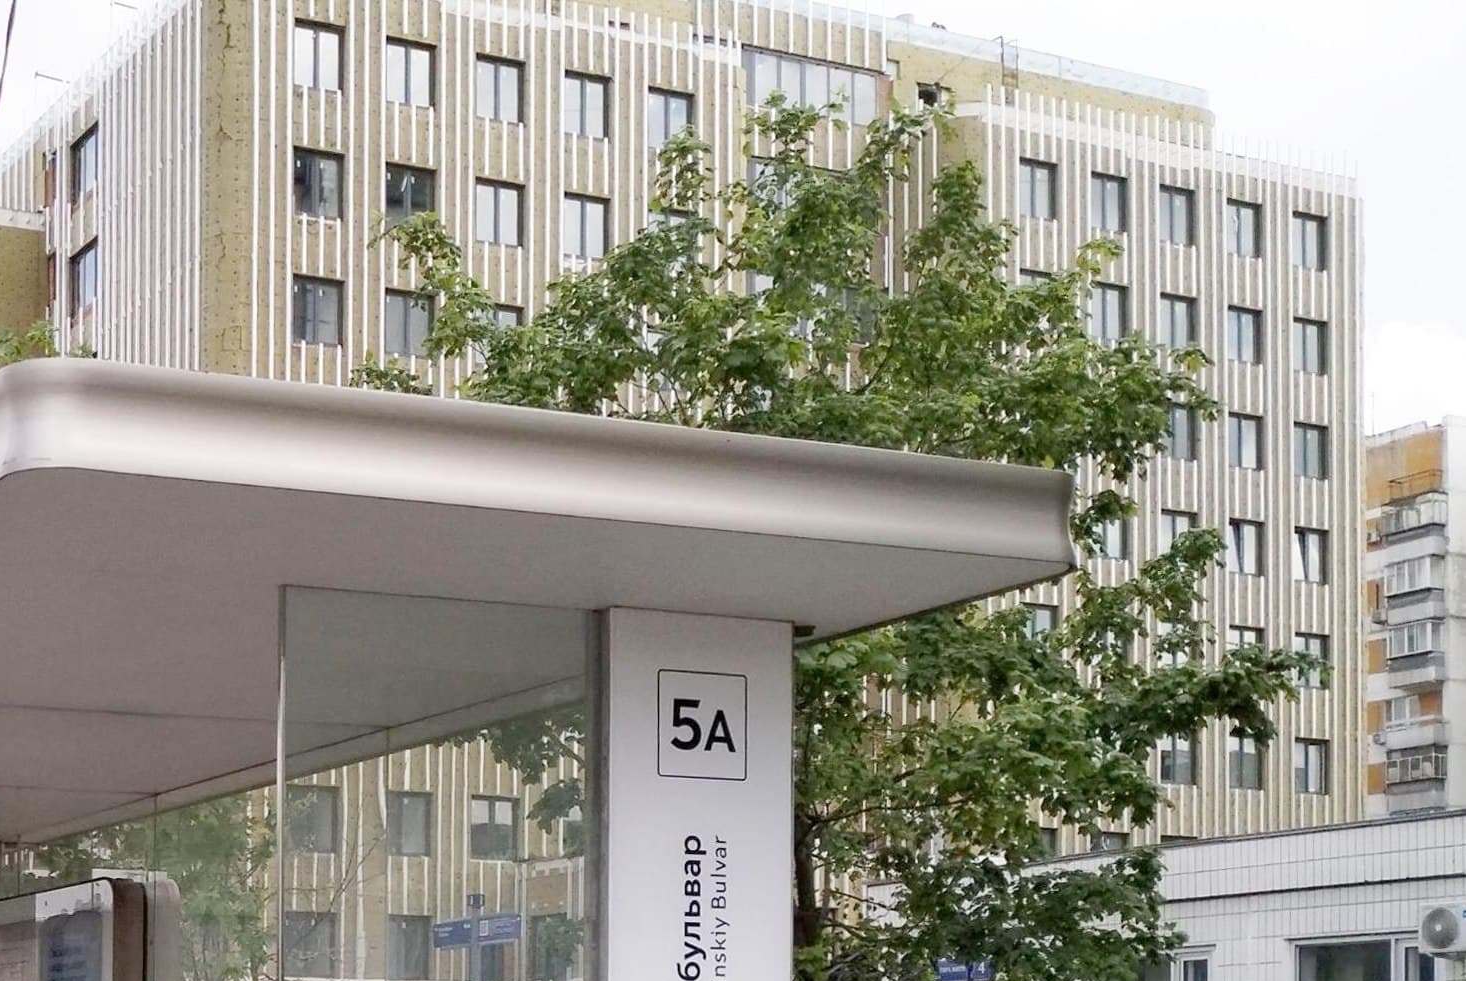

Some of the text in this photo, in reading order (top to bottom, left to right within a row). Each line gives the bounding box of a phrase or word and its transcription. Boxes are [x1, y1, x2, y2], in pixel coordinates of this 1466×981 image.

[676, 834, 707, 981] бульвар
[709, 834, 727, 910] Bulvar
[977, 961, 985, 974] 4
